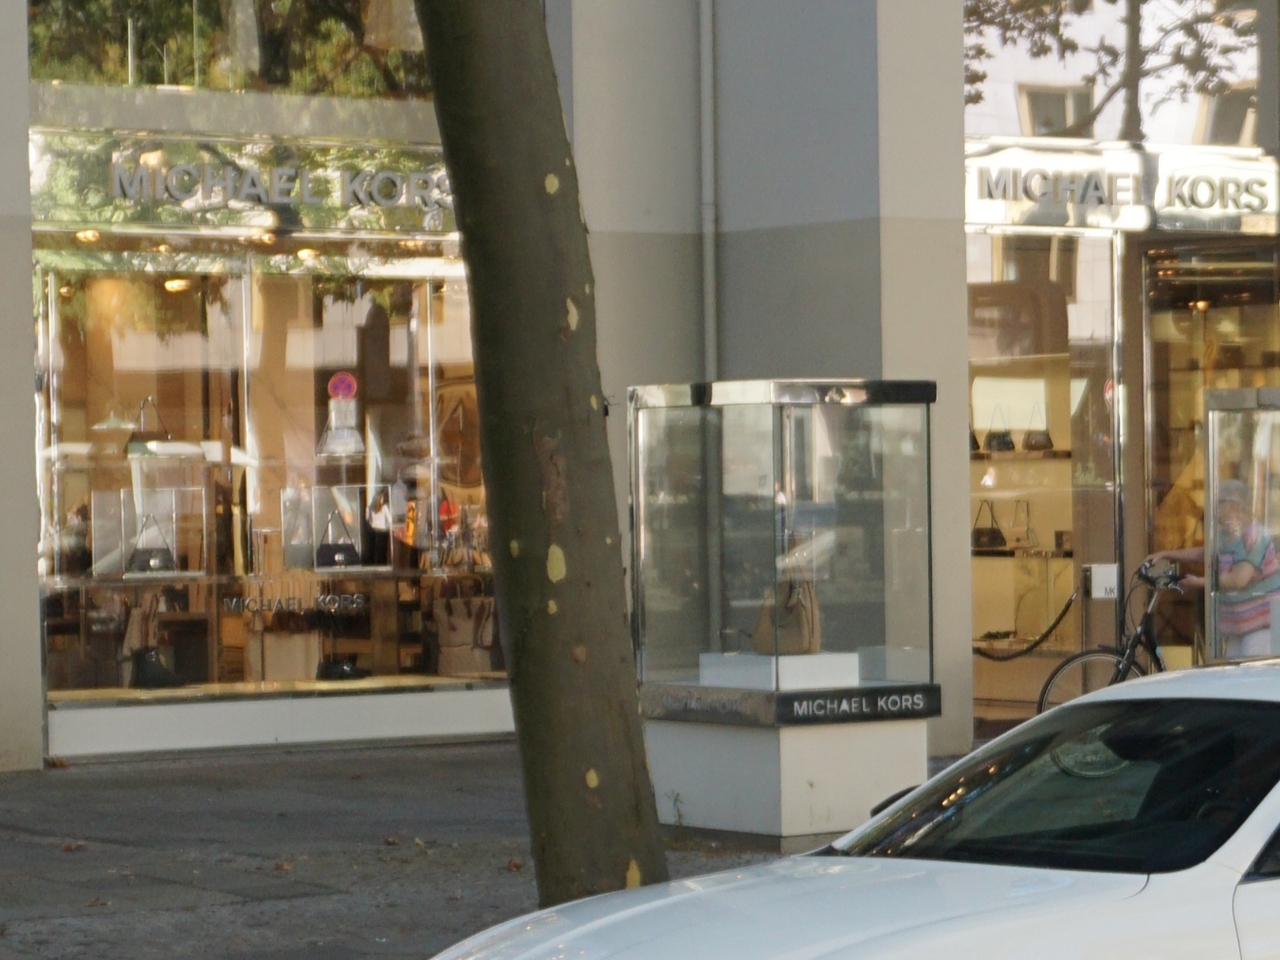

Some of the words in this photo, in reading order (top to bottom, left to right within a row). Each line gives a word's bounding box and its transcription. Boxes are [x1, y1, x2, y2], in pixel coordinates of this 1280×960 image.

[110, 163, 330, 205] MICHAEL
[977, 167, 1145, 206] MICHAEL
[1167, 175, 1269, 212] KORS
[223, 596, 307, 613] MICHAEL
[314, 593, 365, 611] KORS
[793, 697, 870, 716] MICHAEL
[877, 694, 924, 711] KORS
